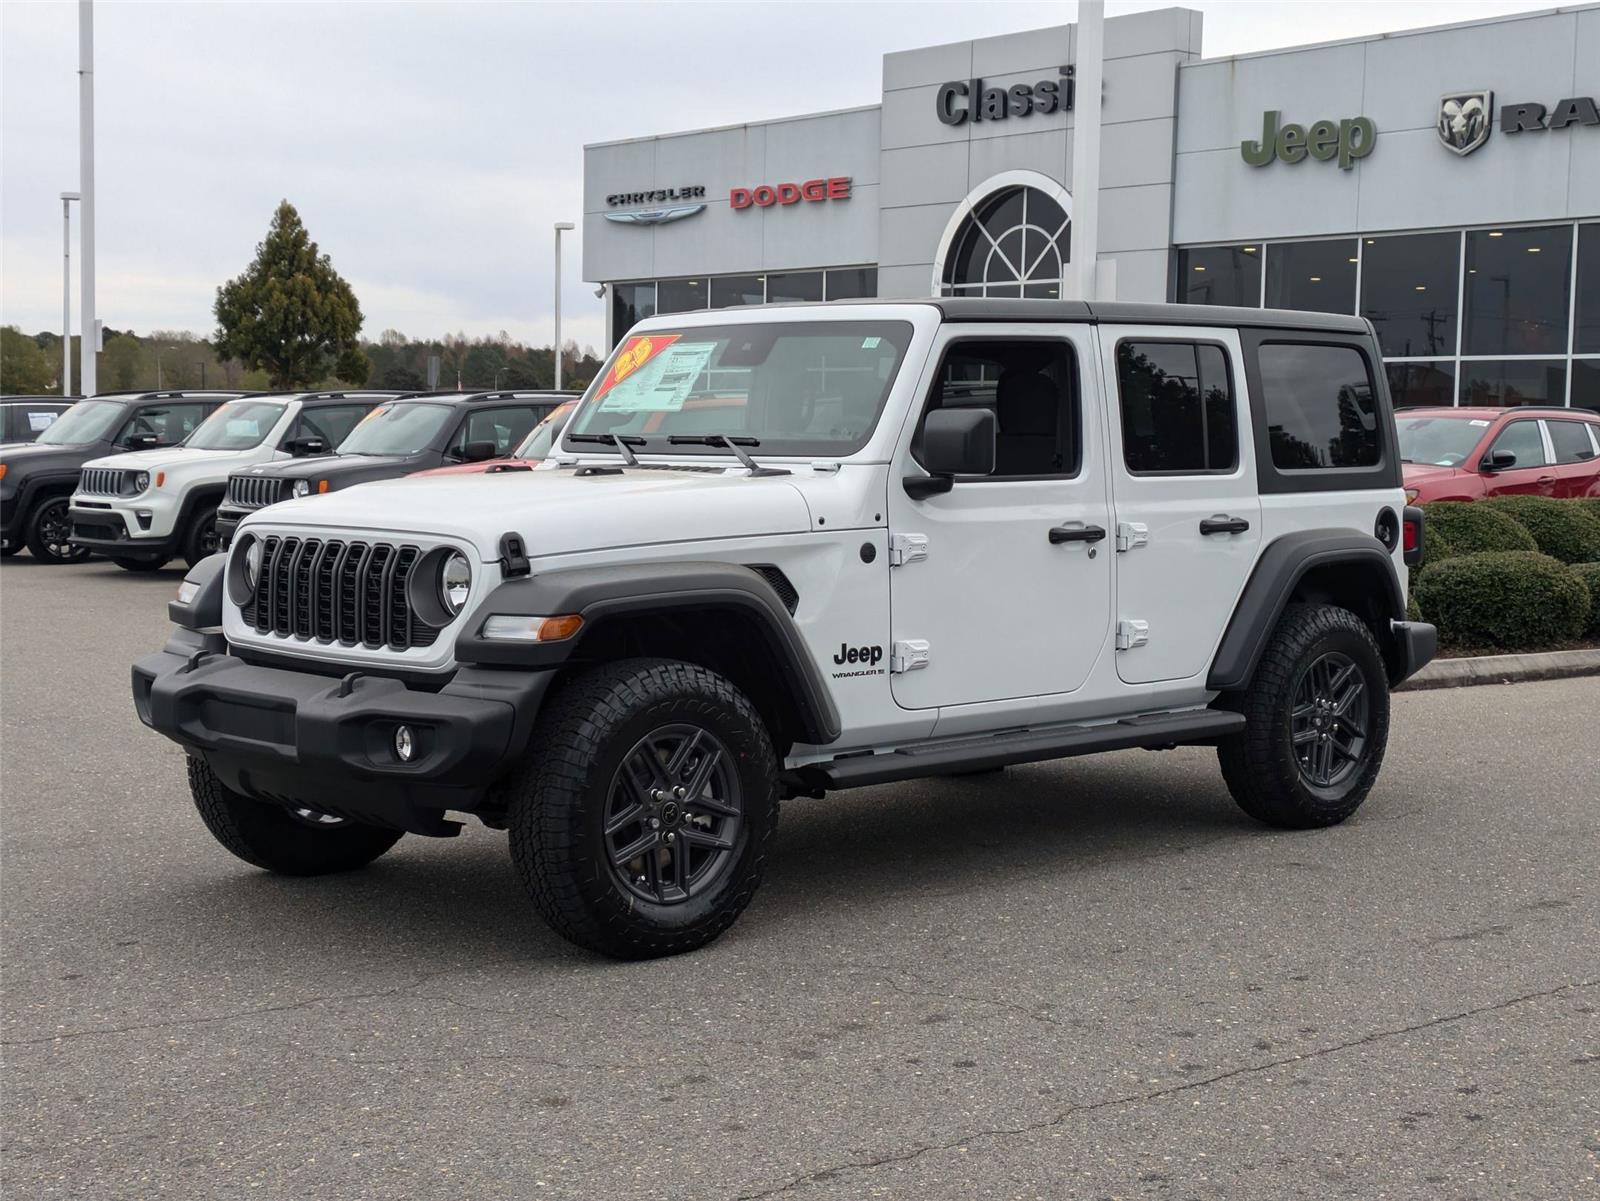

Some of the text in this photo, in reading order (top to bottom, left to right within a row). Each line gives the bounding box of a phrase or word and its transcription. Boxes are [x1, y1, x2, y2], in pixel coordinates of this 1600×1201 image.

[936, 65, 1104, 124] Classi
[1501, 97, 1600, 133] RA
[1241, 111, 1377, 171] Jeep
[606, 185, 706, 208] CHRYSLER
[730, 177, 852, 210] DODGE
[833, 643, 883, 666] Jeep
[832, 670, 877, 679] WRANGLER
